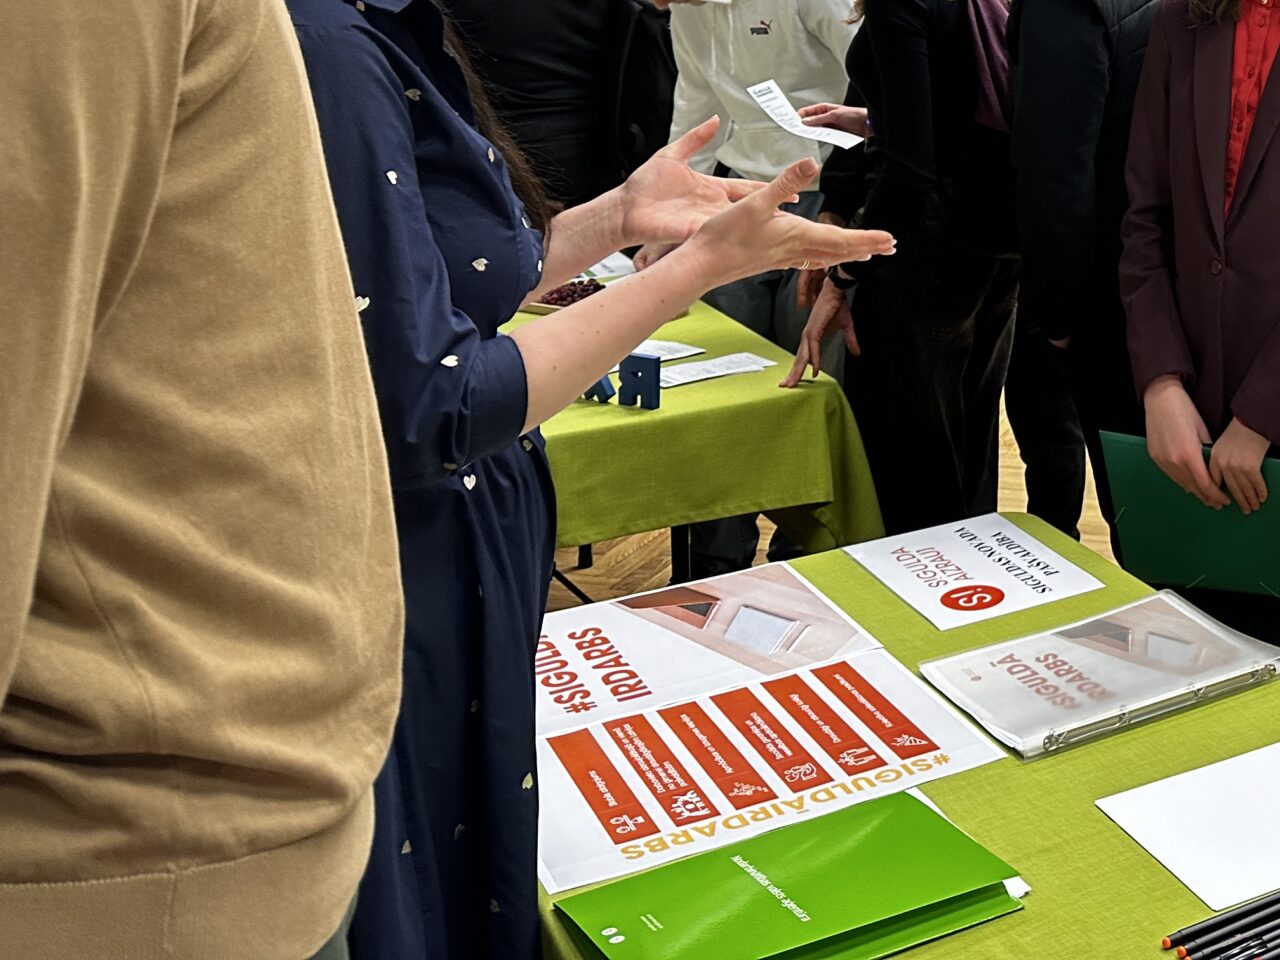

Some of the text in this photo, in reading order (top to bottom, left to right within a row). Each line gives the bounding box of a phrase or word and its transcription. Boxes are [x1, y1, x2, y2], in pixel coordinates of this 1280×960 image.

[916, 547, 974, 581] AIZRAUJ
[954, 526, 1053, 594] SIGULDAS NOVADA
[993, 531, 1060, 577] PAŠVALDĪBA
[535, 634, 598, 714] #SIGULD
[567, 627, 653, 702] IRDARBS
[619, 754, 952, 861] #SIGULDĀIRDARBS
